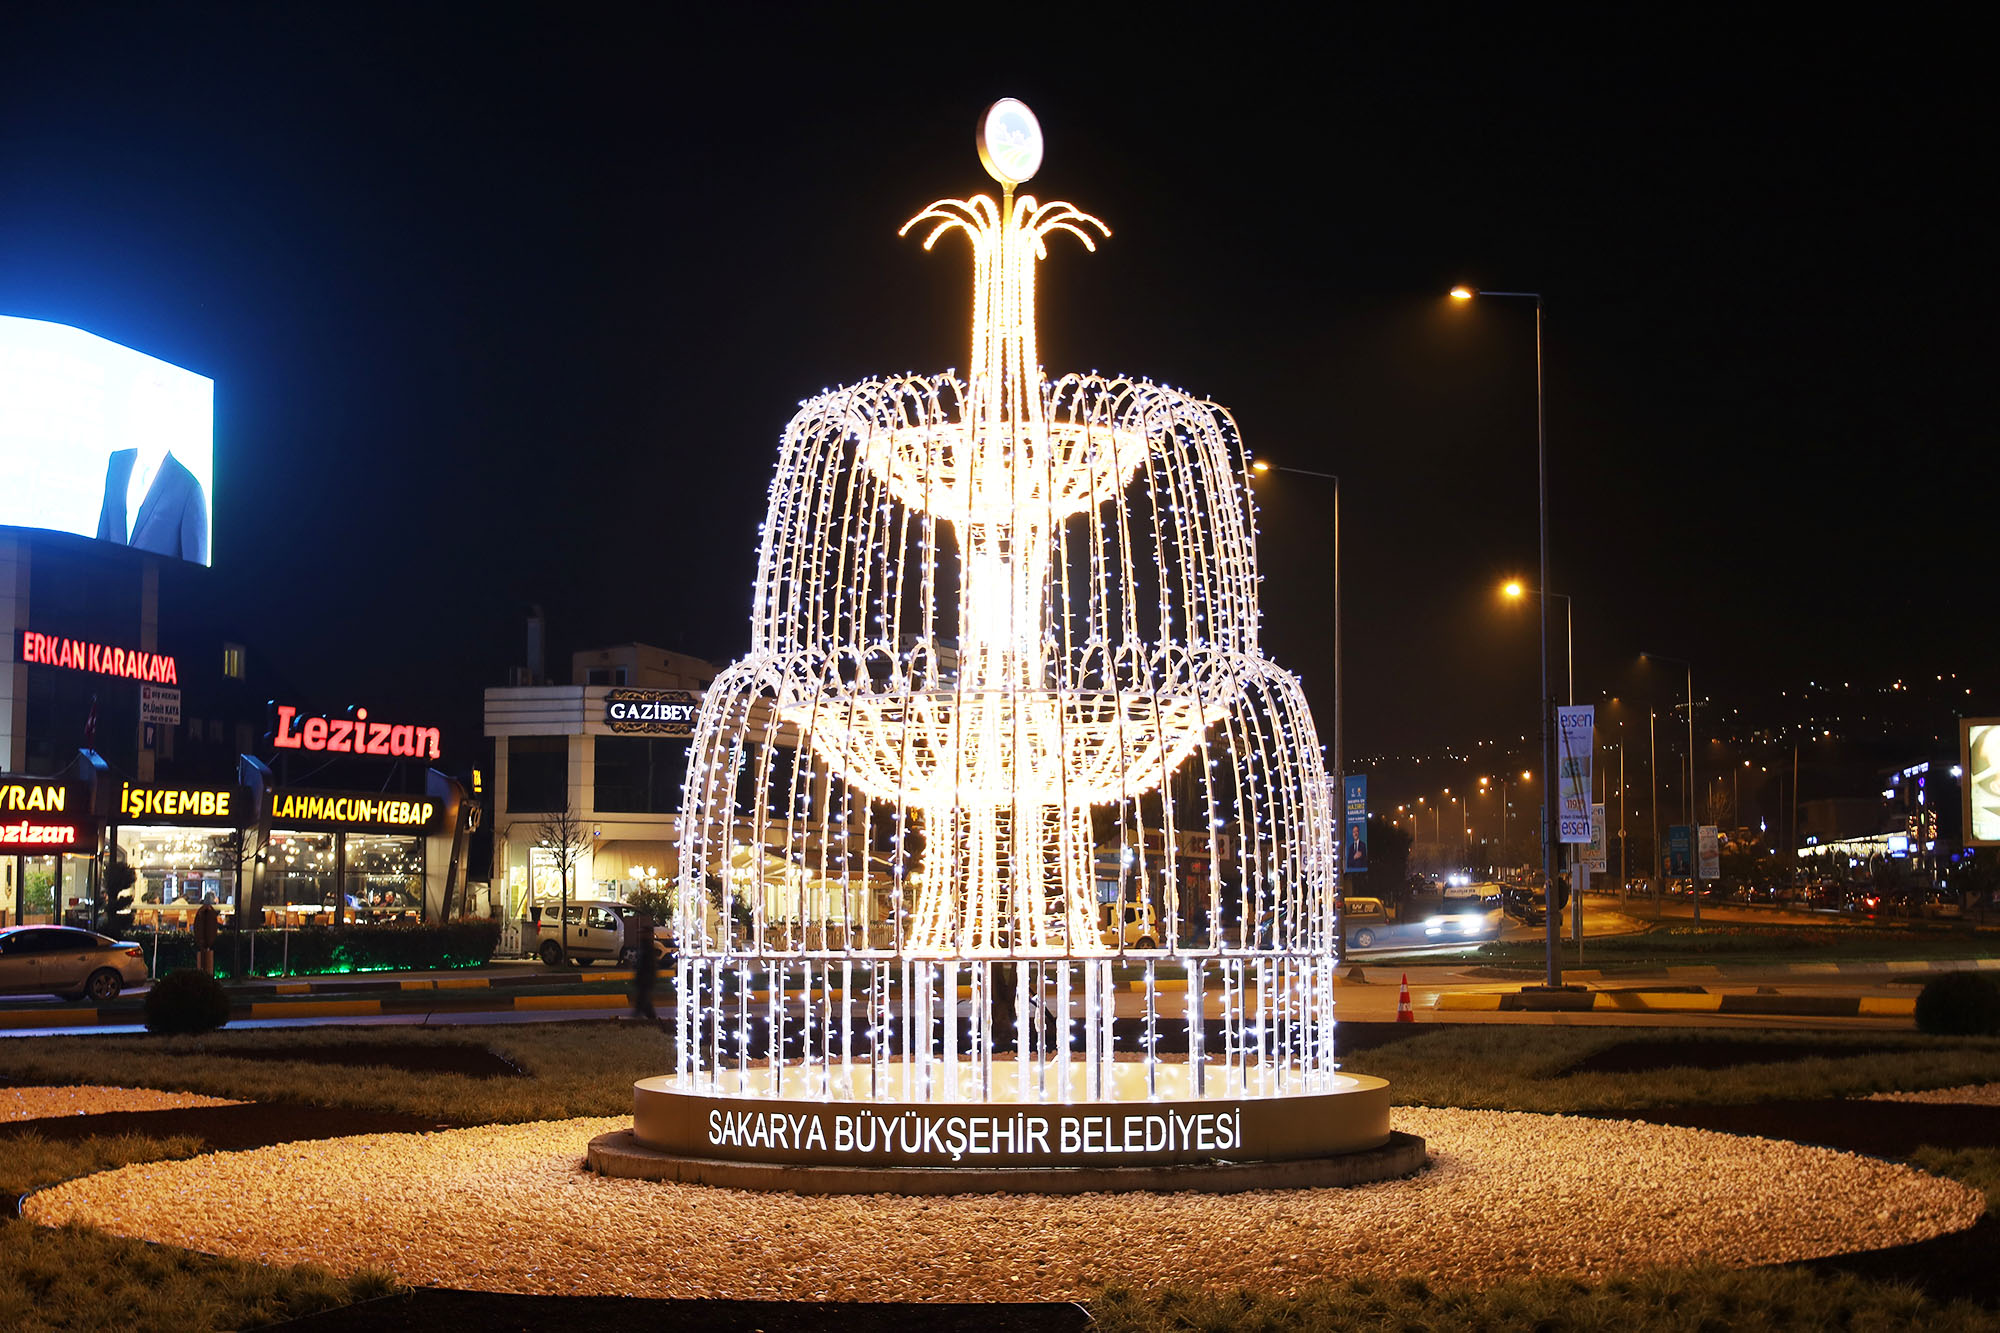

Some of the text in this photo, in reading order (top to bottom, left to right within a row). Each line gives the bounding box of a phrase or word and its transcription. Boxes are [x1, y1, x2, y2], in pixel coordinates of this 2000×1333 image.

[23, 630, 178, 685] ERKAN KARAKAYA
[610, 701, 695, 722] GAZİBEY
[1560, 713, 1592, 728] essen
[273, 705, 441, 760] Lezizan
[121, 781, 230, 818] İŞKEMBE
[272, 794, 434, 826] LAHMACUN-KEBAP
[1561, 821, 1590, 836] essen
[708, 1107, 1241, 1162] SAKARYA BÜYÜKŞEHİR BELEDİYESİ
